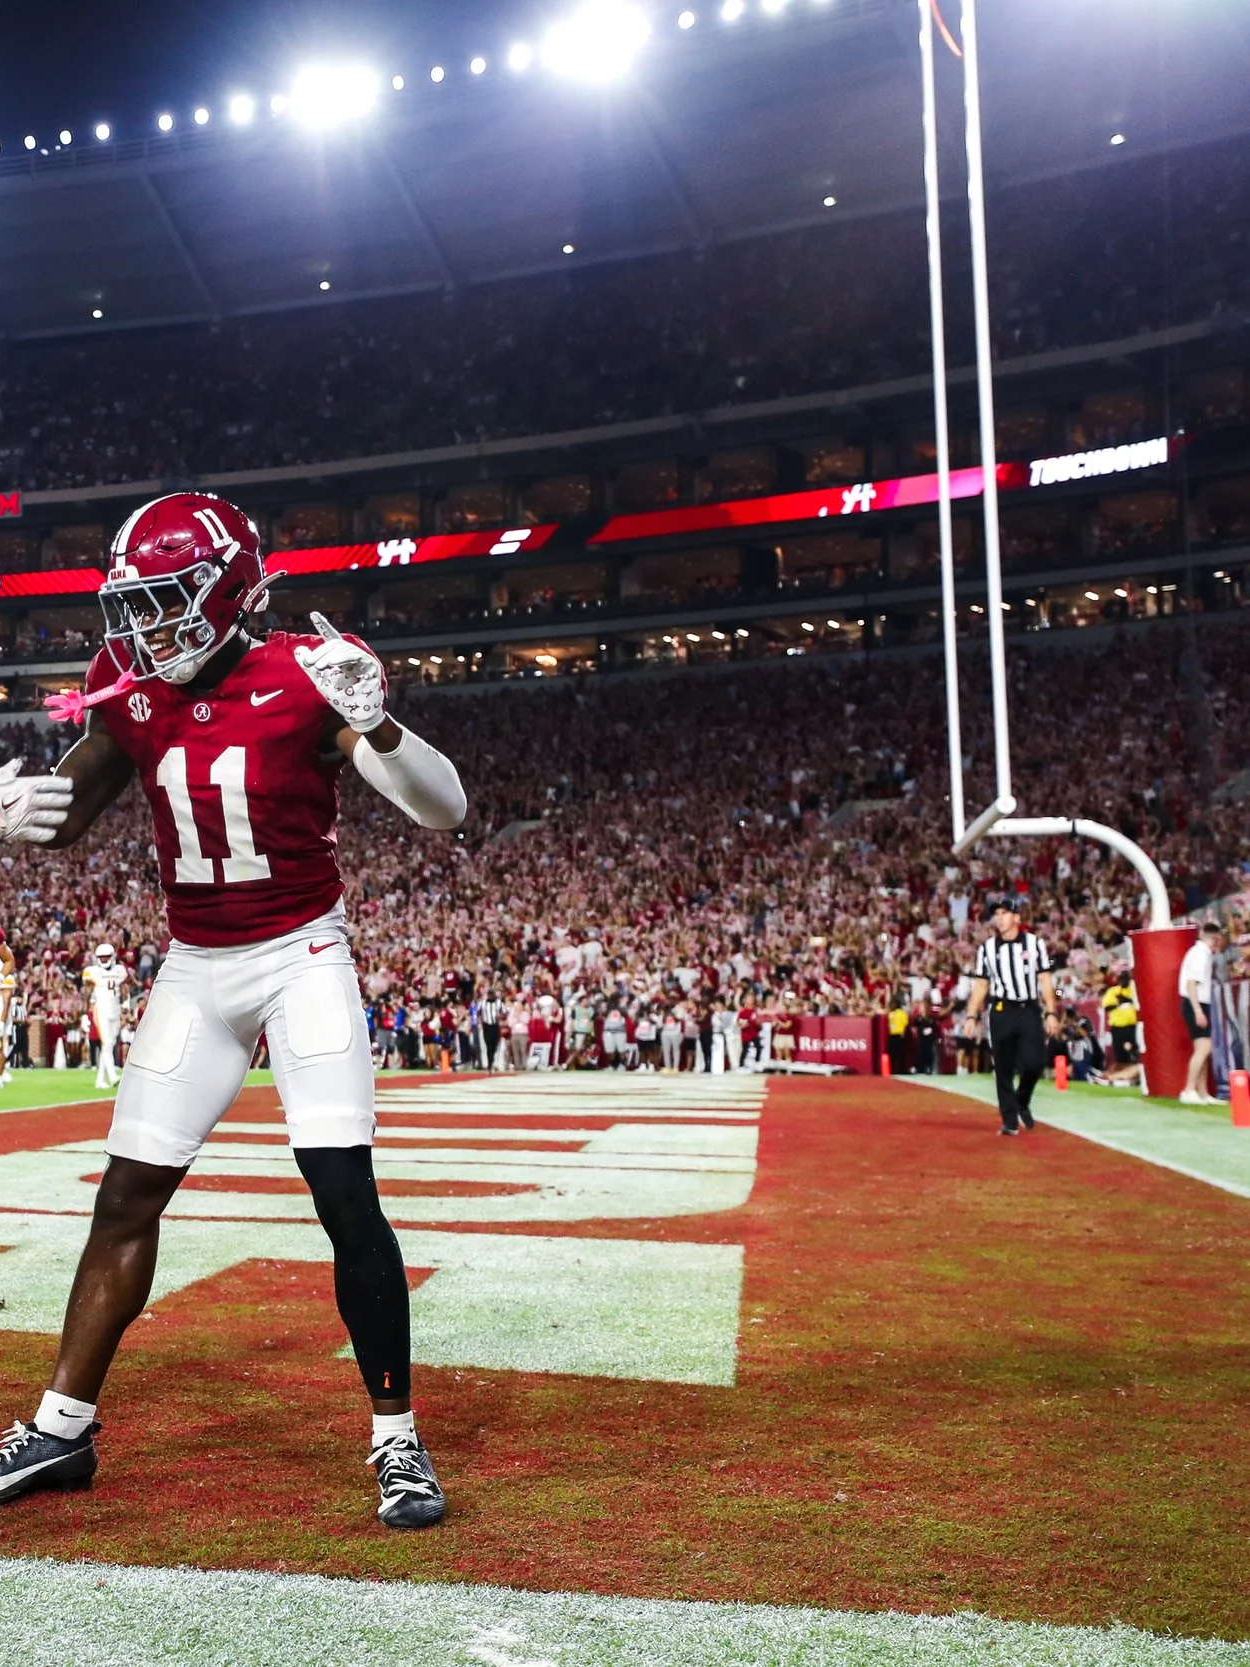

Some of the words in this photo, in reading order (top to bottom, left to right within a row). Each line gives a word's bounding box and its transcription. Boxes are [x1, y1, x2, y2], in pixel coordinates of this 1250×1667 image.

[1029, 437, 1168, 487] TOUCHDOWN
[192, 508, 234, 549] 11
[127, 692, 152, 723] SEC
[156, 745, 272, 884] 11
[798, 1035, 868, 1053] REGIONS
